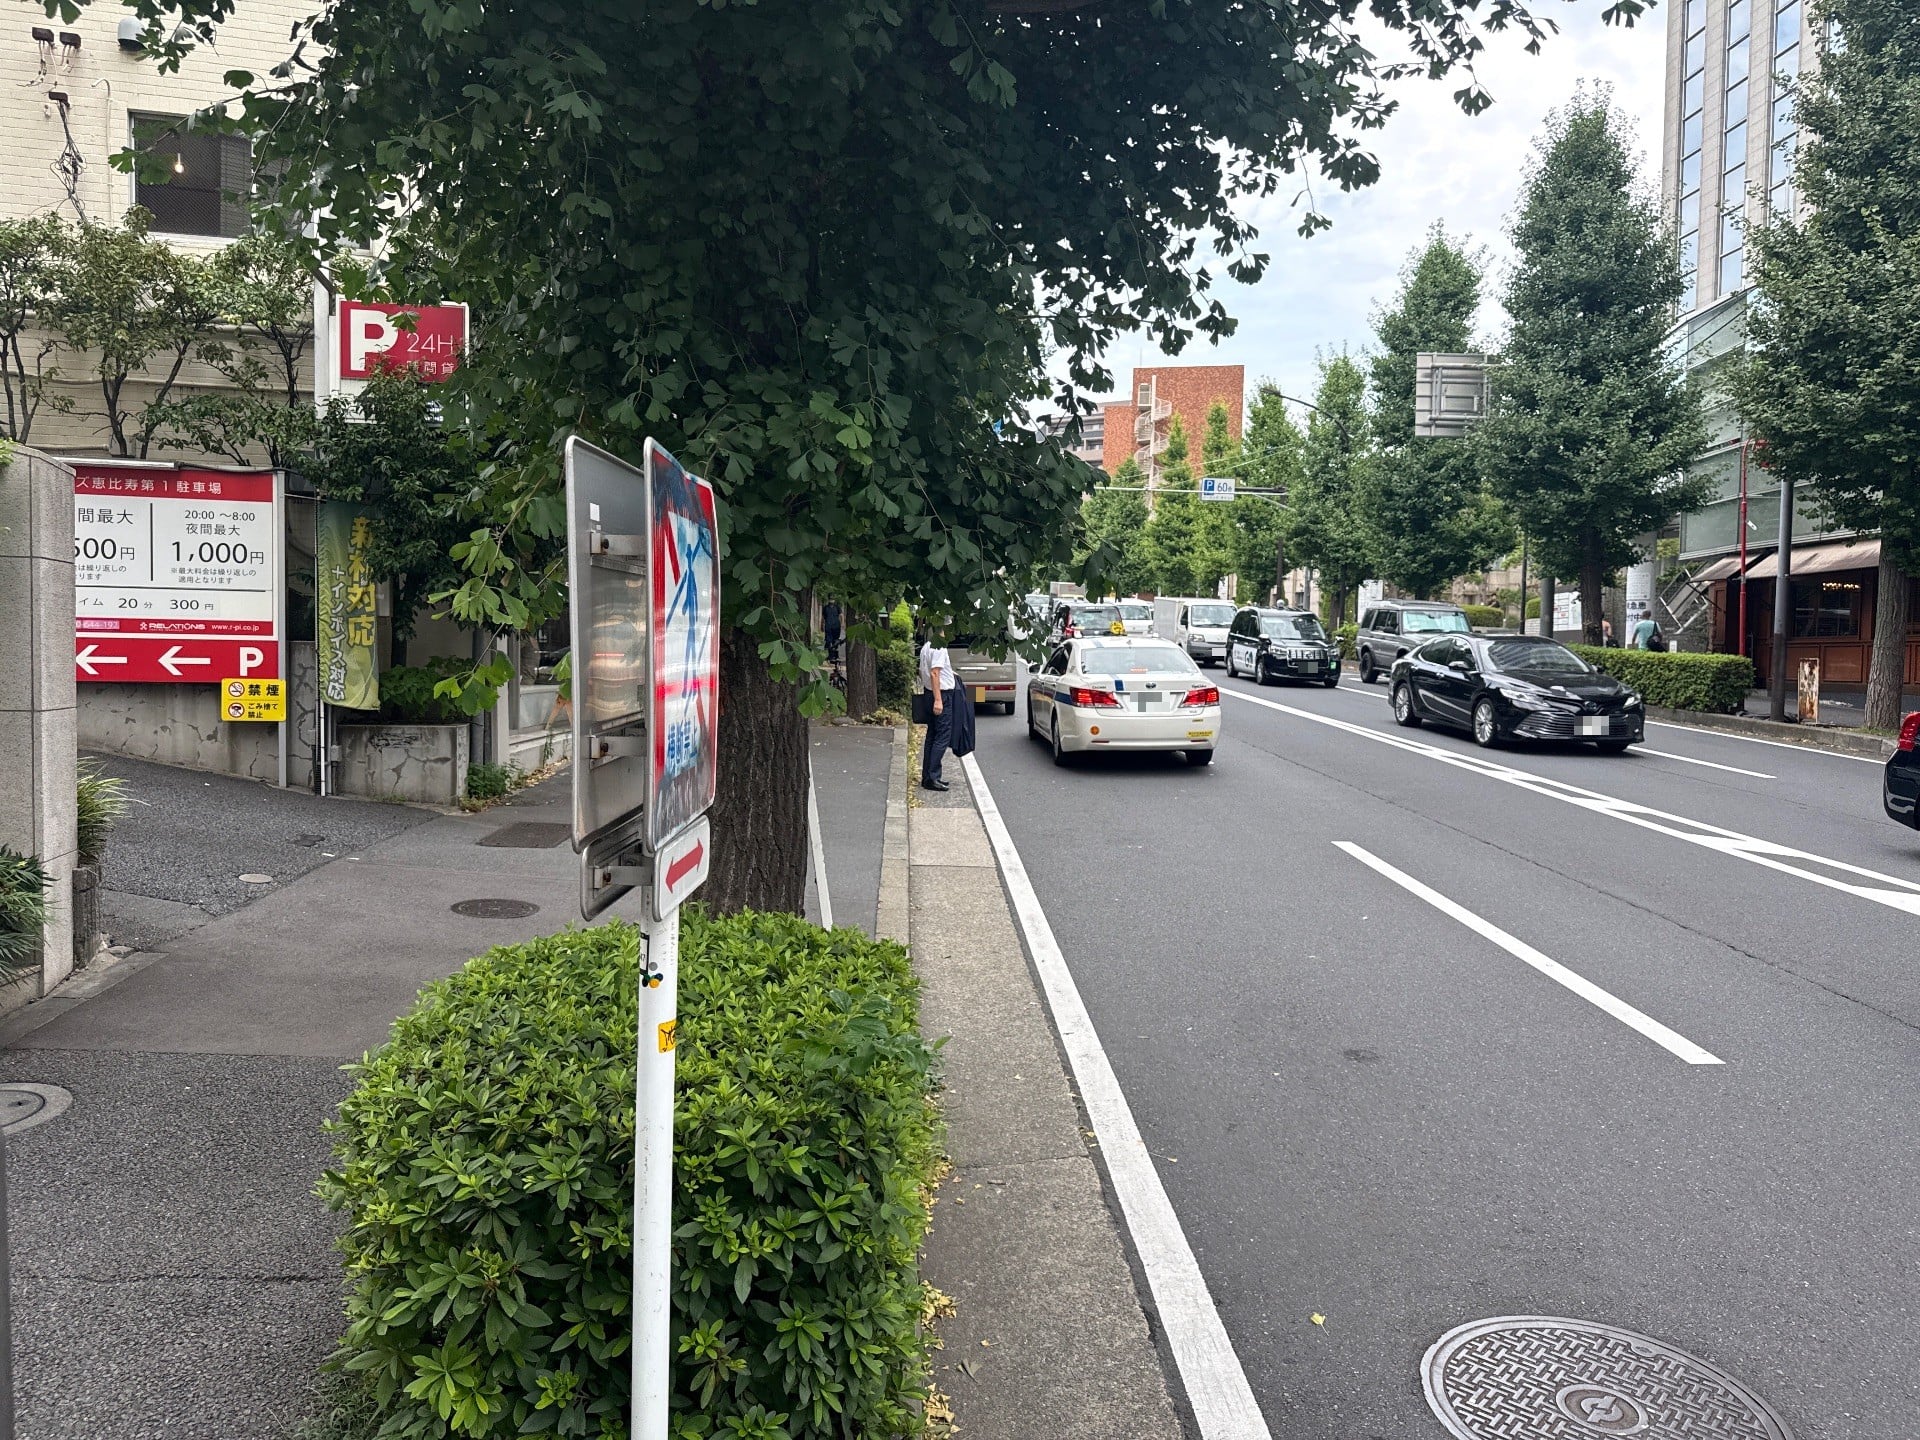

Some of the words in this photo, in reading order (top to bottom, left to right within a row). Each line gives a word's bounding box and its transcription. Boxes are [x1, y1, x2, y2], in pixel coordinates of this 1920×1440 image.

[350, 309, 398, 371] P
[406, 333, 453, 354] 24H
[184, 510, 215, 520] 20:00
[185, 523, 240, 536] 夜間最大
[75, 564, 127, 573] は繰り返しの
[75, 573, 102, 581] ります
[118, 598, 138, 608] 20
[143, 601, 153, 609] 分
[169, 599, 199, 610] 300
[239, 646, 264, 677] P
[248, 684, 279, 697] 禁煙
[248, 702, 278, 711] ごみ捨て
[247, 711, 263, 719] 禁止
